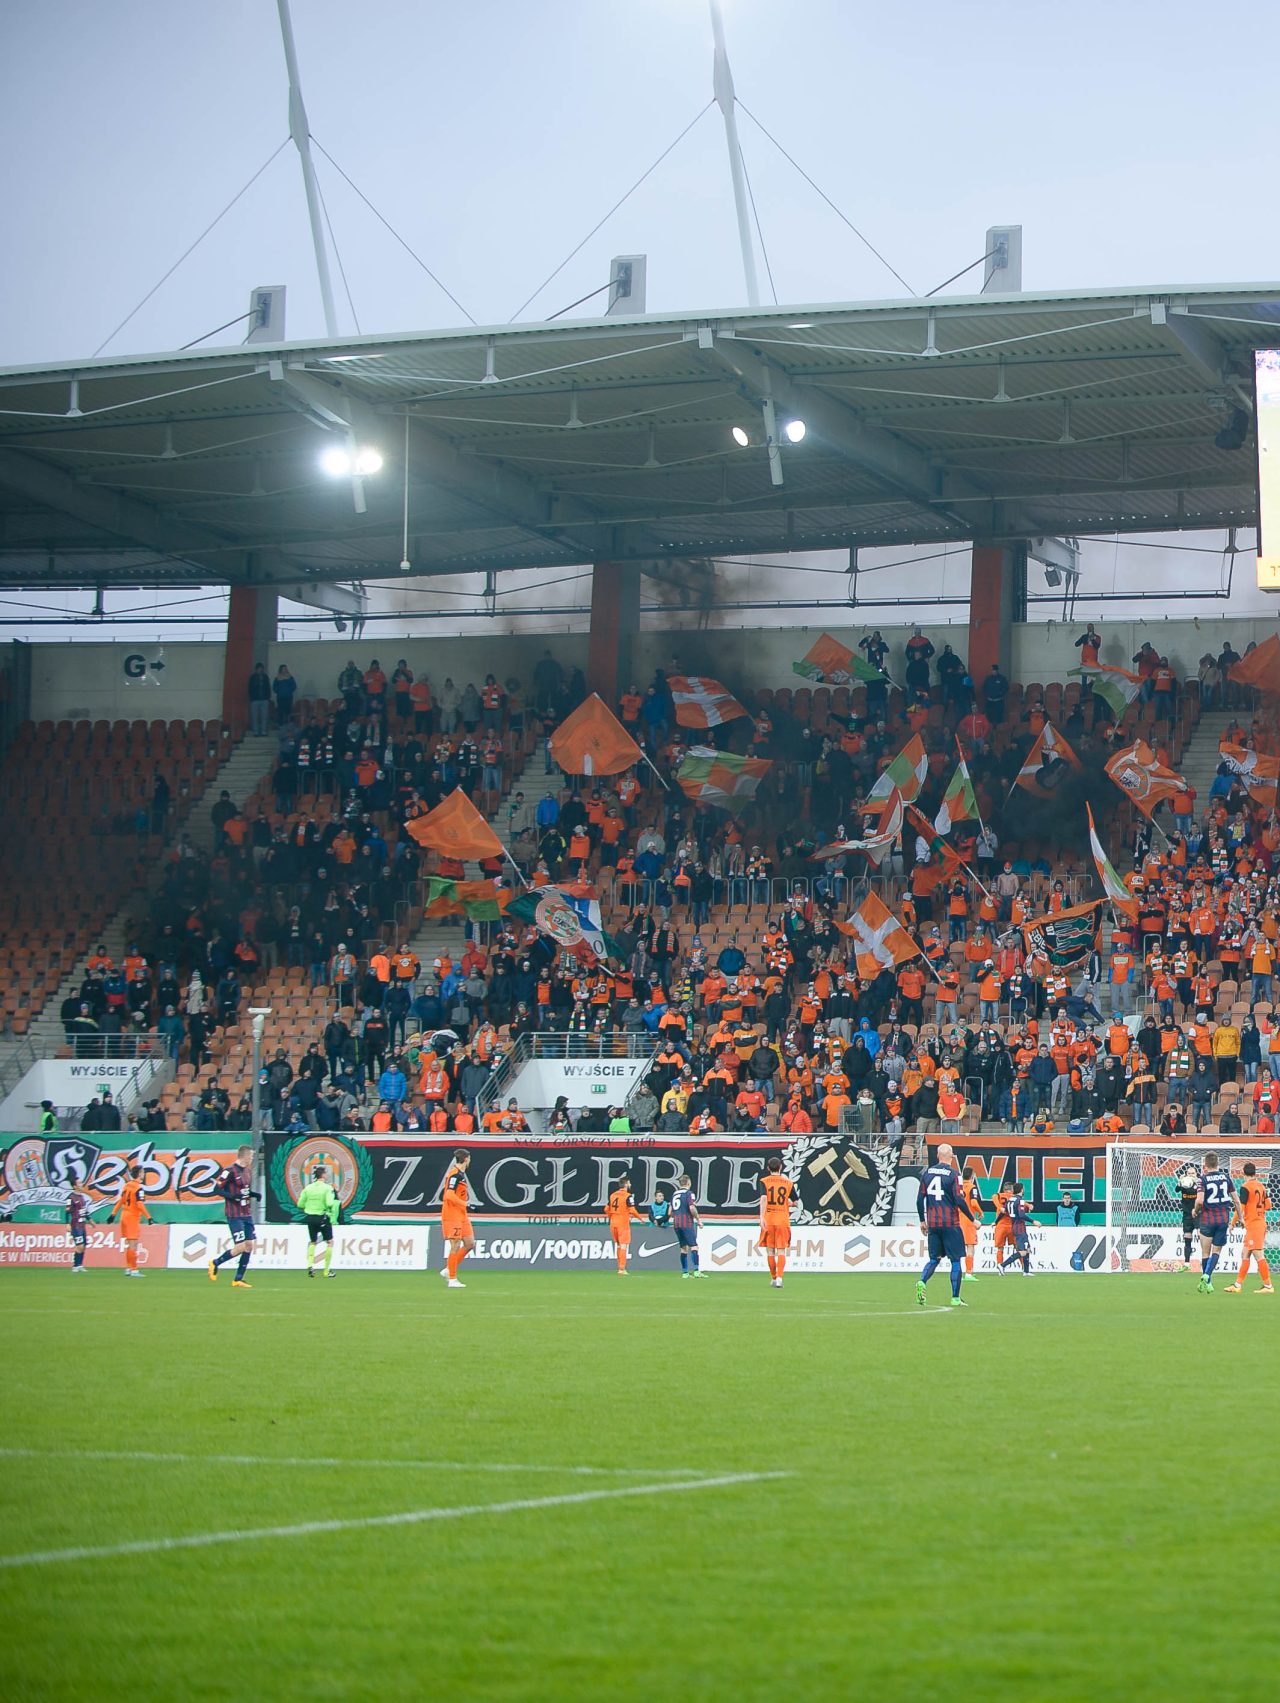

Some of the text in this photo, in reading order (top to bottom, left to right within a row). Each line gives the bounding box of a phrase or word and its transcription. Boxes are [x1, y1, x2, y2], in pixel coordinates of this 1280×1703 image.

[124, 654, 147, 678] G
[70, 1064, 128, 1076] WYJŚCIE
[563, 1063, 637, 1076] WYJŚCIE 7
[767, 1186, 787, 1206] 18
[926, 1176, 945, 1201] 4
[1206, 1181, 1233, 1204] 21
[672, 1194, 681, 1210] 6
[233, 1230, 246, 1242] 23
[217, 1238, 289, 1255] KHM
[341, 1238, 414, 1256] KGHM
[747, 1239, 825, 1257] KHM
